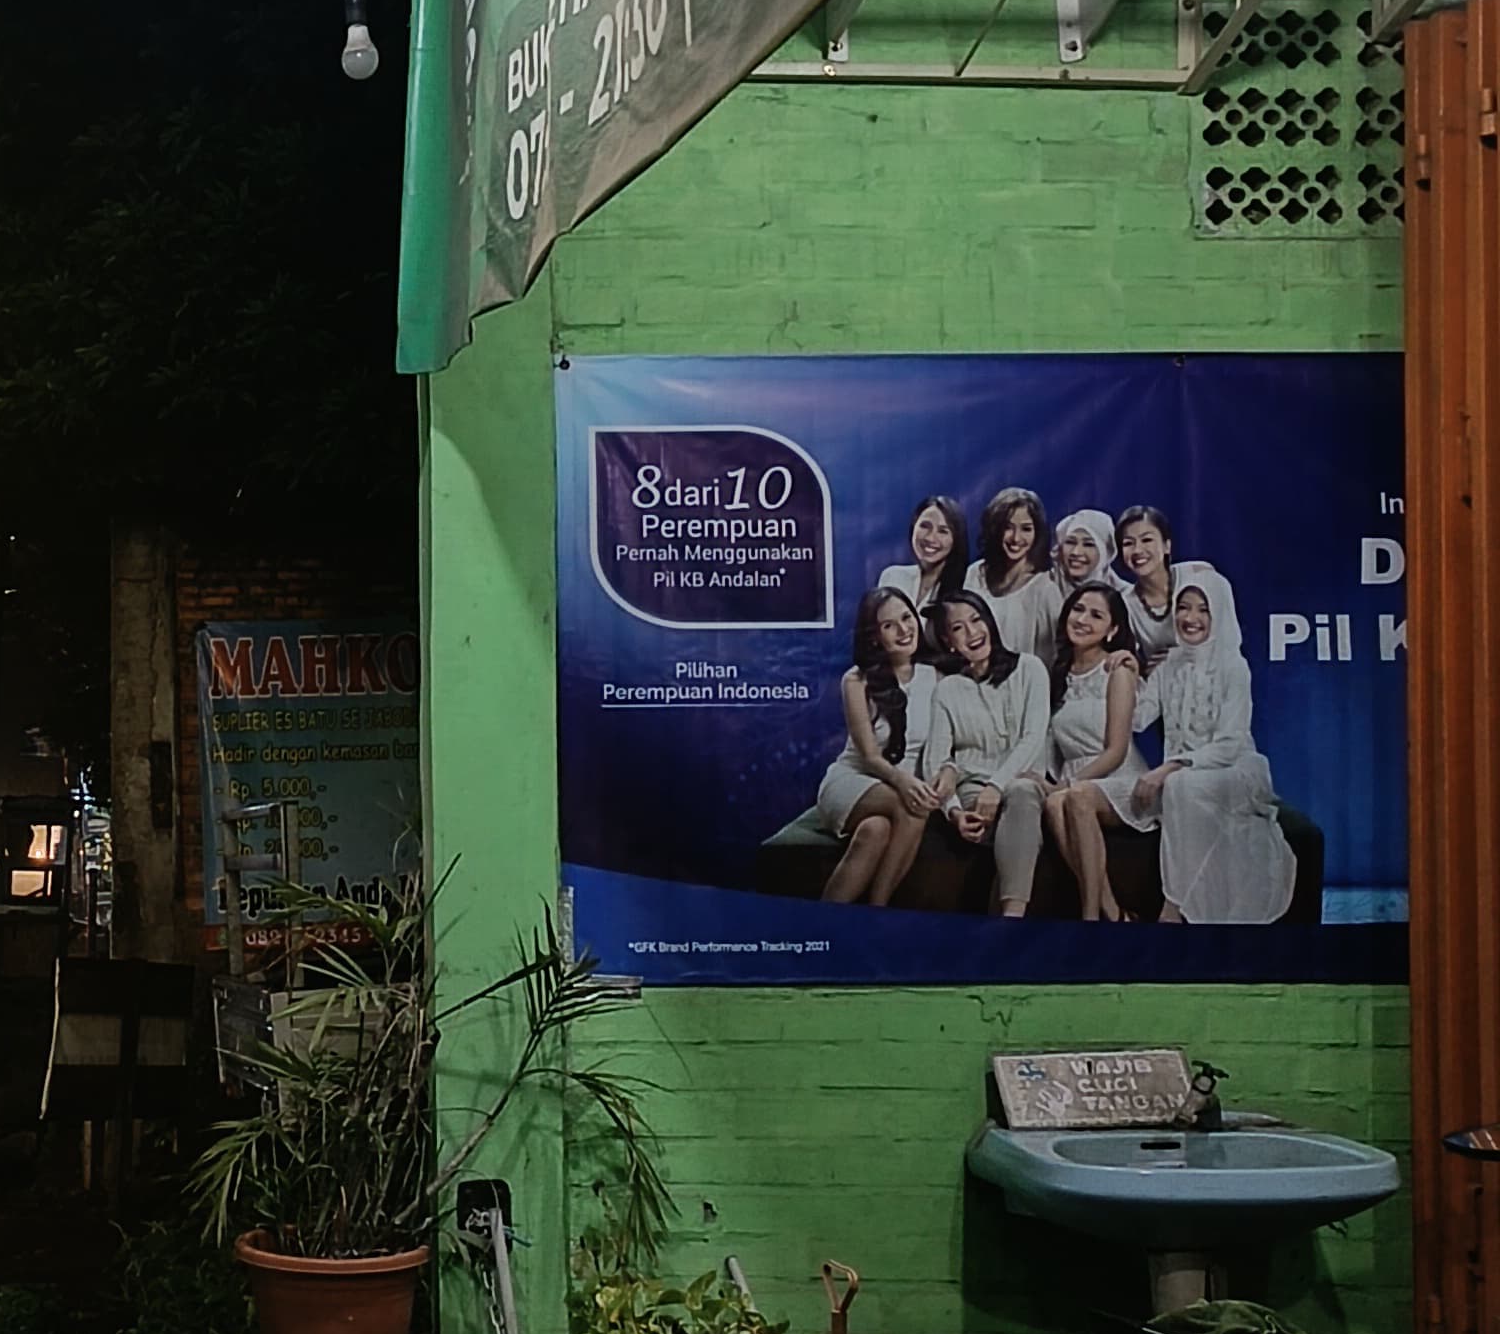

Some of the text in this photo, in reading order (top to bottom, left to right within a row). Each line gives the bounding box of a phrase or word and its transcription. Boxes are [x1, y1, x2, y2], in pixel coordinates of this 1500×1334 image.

[508, 19, 555, 114] BUK
[643, 515, 796, 543] Perempuan
[616, 545, 813, 564] Pernah Menggunakan
[654, 571, 675, 587] Pil
[681, 572, 704, 587] KB
[1269, 614, 1352, 661] Pil
[676, 662, 737, 679] Pilihan
[603, 682, 809, 703] Perempuan Indonesia
[212, 710, 268, 732] SUPLIER
[275, 710, 292, 731] ES
[299, 709, 336, 731] BATU
[212, 742, 256, 763] Hadir
[261, 741, 315, 767] dengan
[322, 741, 388, 762] kemasan
[659, 942, 689, 952] Brand
[692, 942, 757, 952] Performance
[761, 941, 802, 954] Tracking
[805, 941, 829, 951] 2021
[1077, 1077, 1137, 1094] CUCI
[1082, 1092, 1186, 1112] TANGAN
